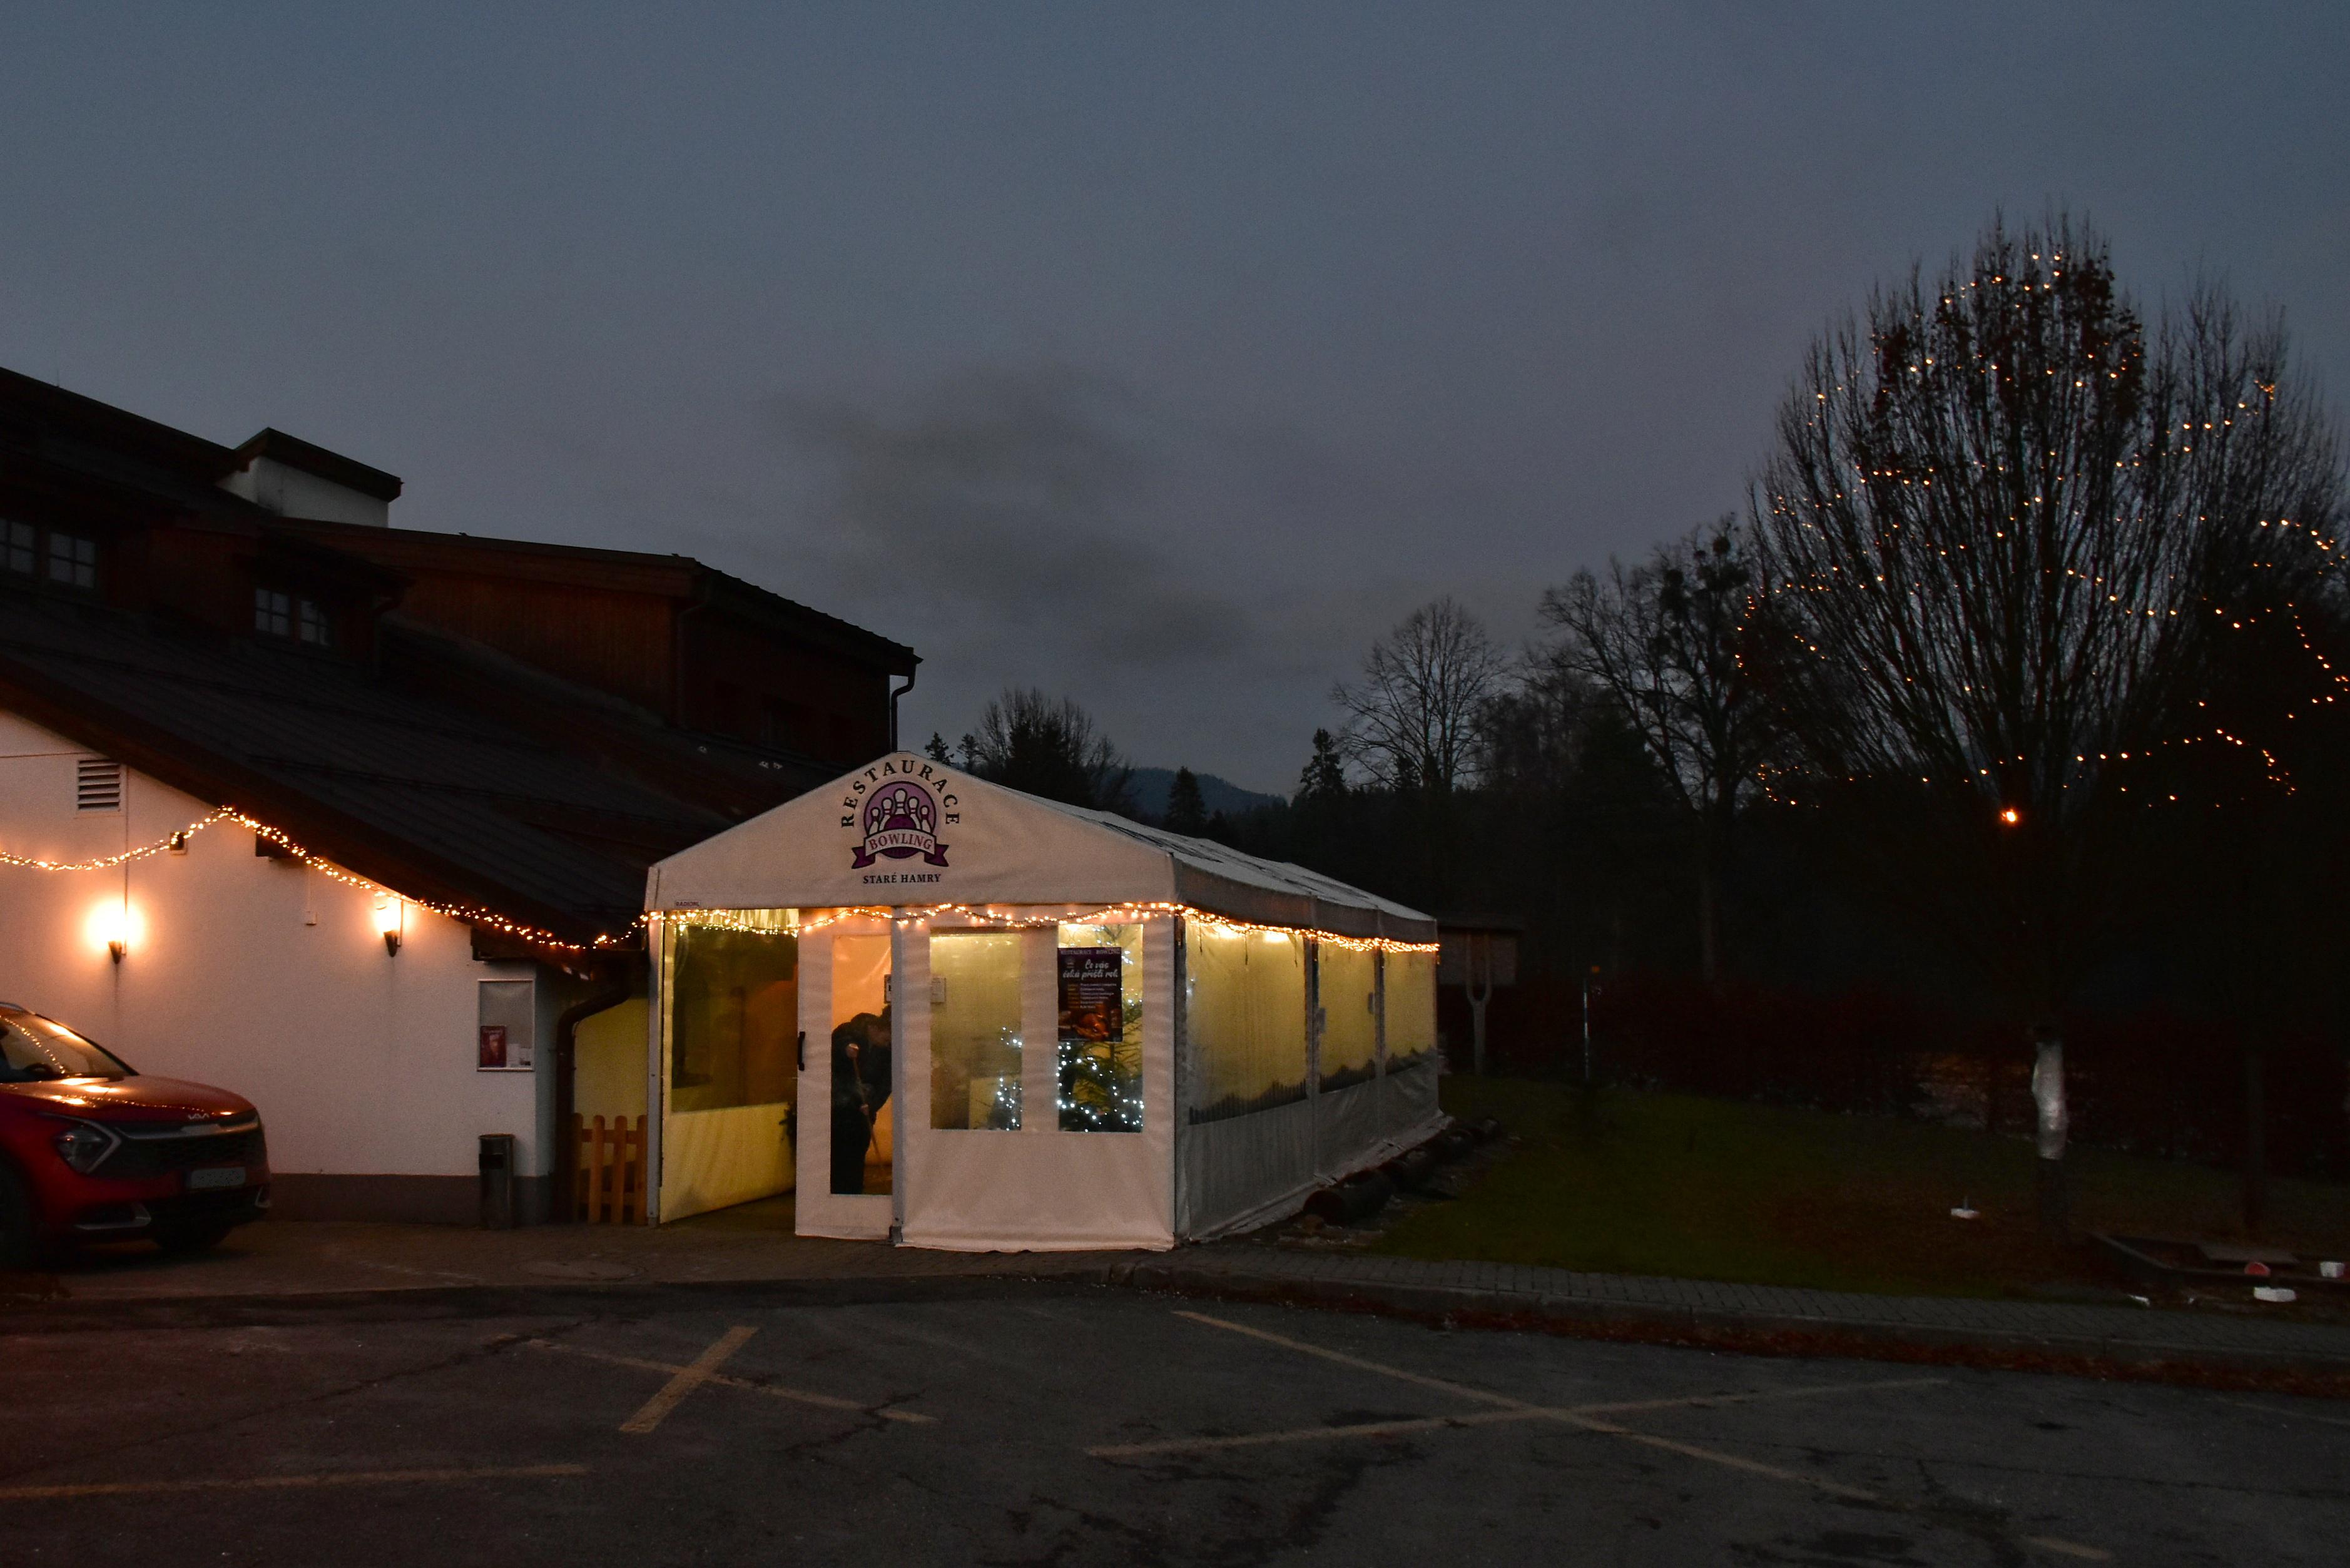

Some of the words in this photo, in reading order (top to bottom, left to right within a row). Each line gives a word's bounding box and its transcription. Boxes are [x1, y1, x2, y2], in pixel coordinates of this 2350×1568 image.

[842, 760, 960, 828] RESTAURACE
[868, 833, 933, 850] BOWLING
[863, 872, 897, 884] STARÉ
[901, 873, 942, 883] HAMRY
